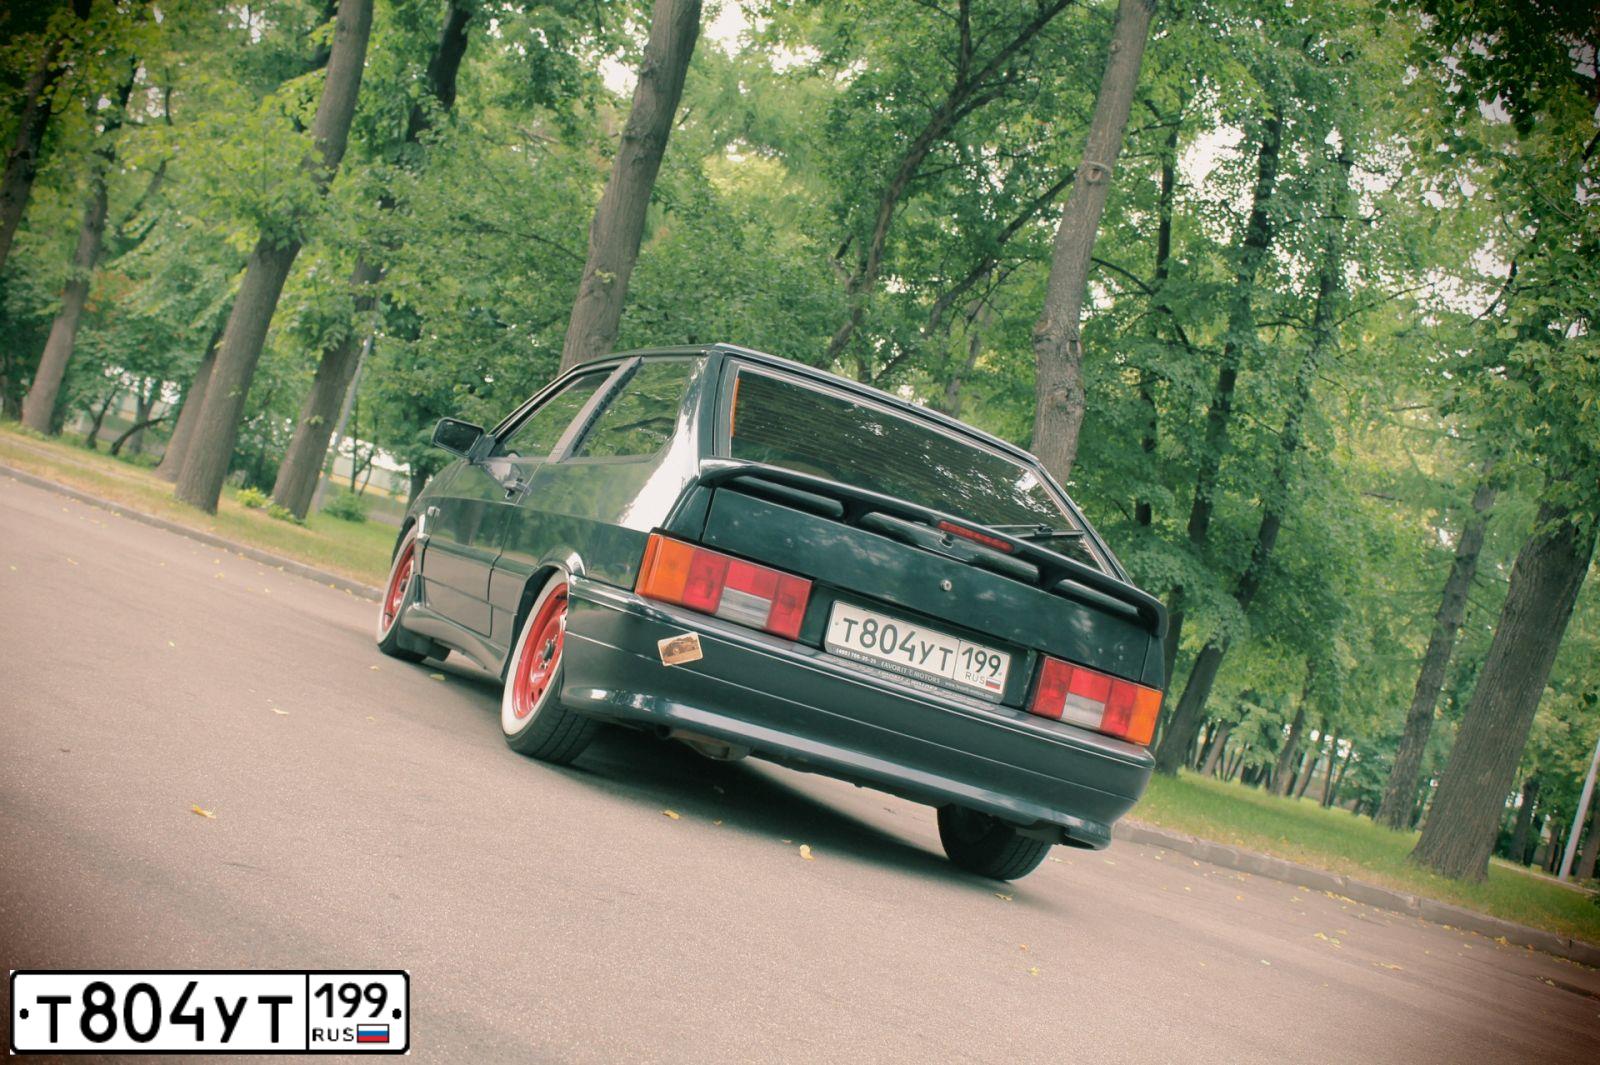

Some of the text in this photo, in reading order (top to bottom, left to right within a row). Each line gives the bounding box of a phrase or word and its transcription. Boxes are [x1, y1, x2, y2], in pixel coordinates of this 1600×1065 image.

[843, 617, 1001, 677] Т804УТ 199
[880, 661, 907, 673] FAVORIT
[913, 671, 940, 683] MOTORS
[965, 671, 985, 685] RUS
